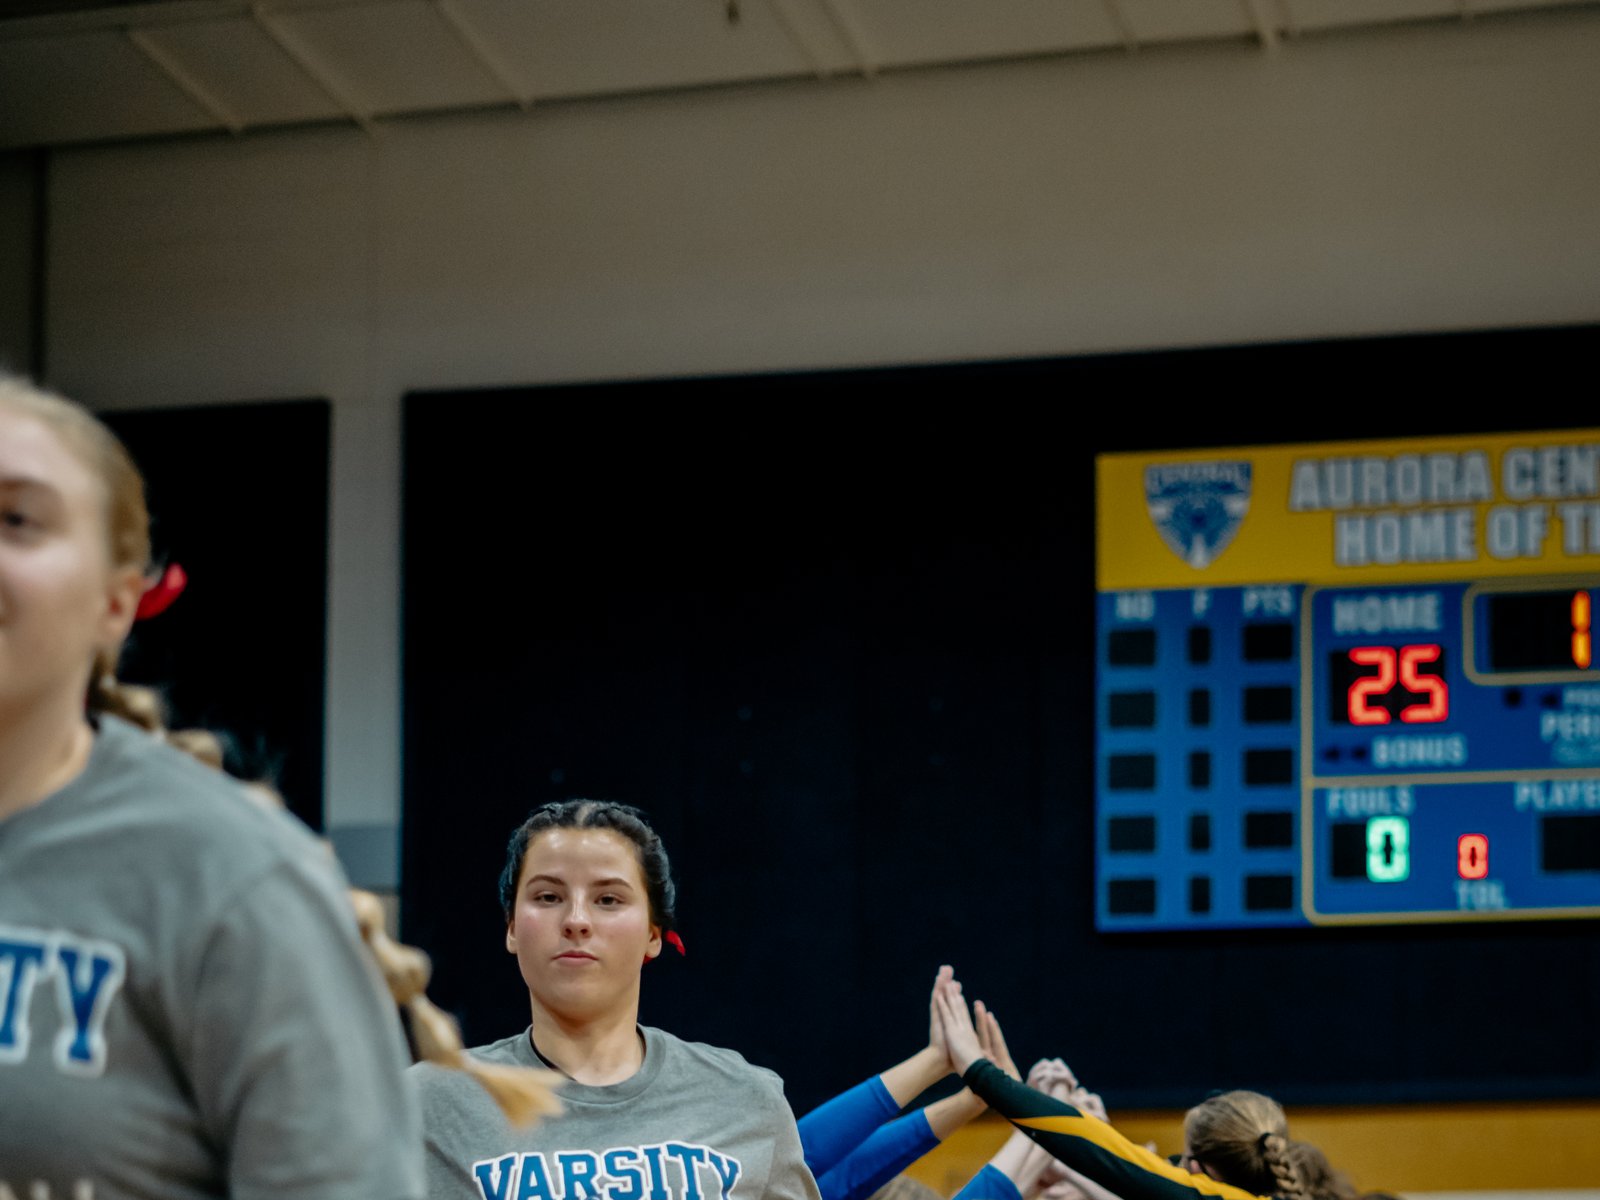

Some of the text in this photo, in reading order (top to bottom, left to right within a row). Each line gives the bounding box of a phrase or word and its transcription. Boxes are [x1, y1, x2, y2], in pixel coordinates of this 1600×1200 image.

[1289, 450, 1494, 512] AURORA
[1333, 507, 1478, 567] HOME
[1486, 504, 1547, 560] OF
[1333, 592, 1441, 634] HOME
[1348, 643, 1448, 726] 25
[1372, 733, 1466, 768] BONUS
[1327, 785, 1413, 817] FOULS
[1366, 815, 1410, 883] 0
[1457, 833, 1488, 880] 0
